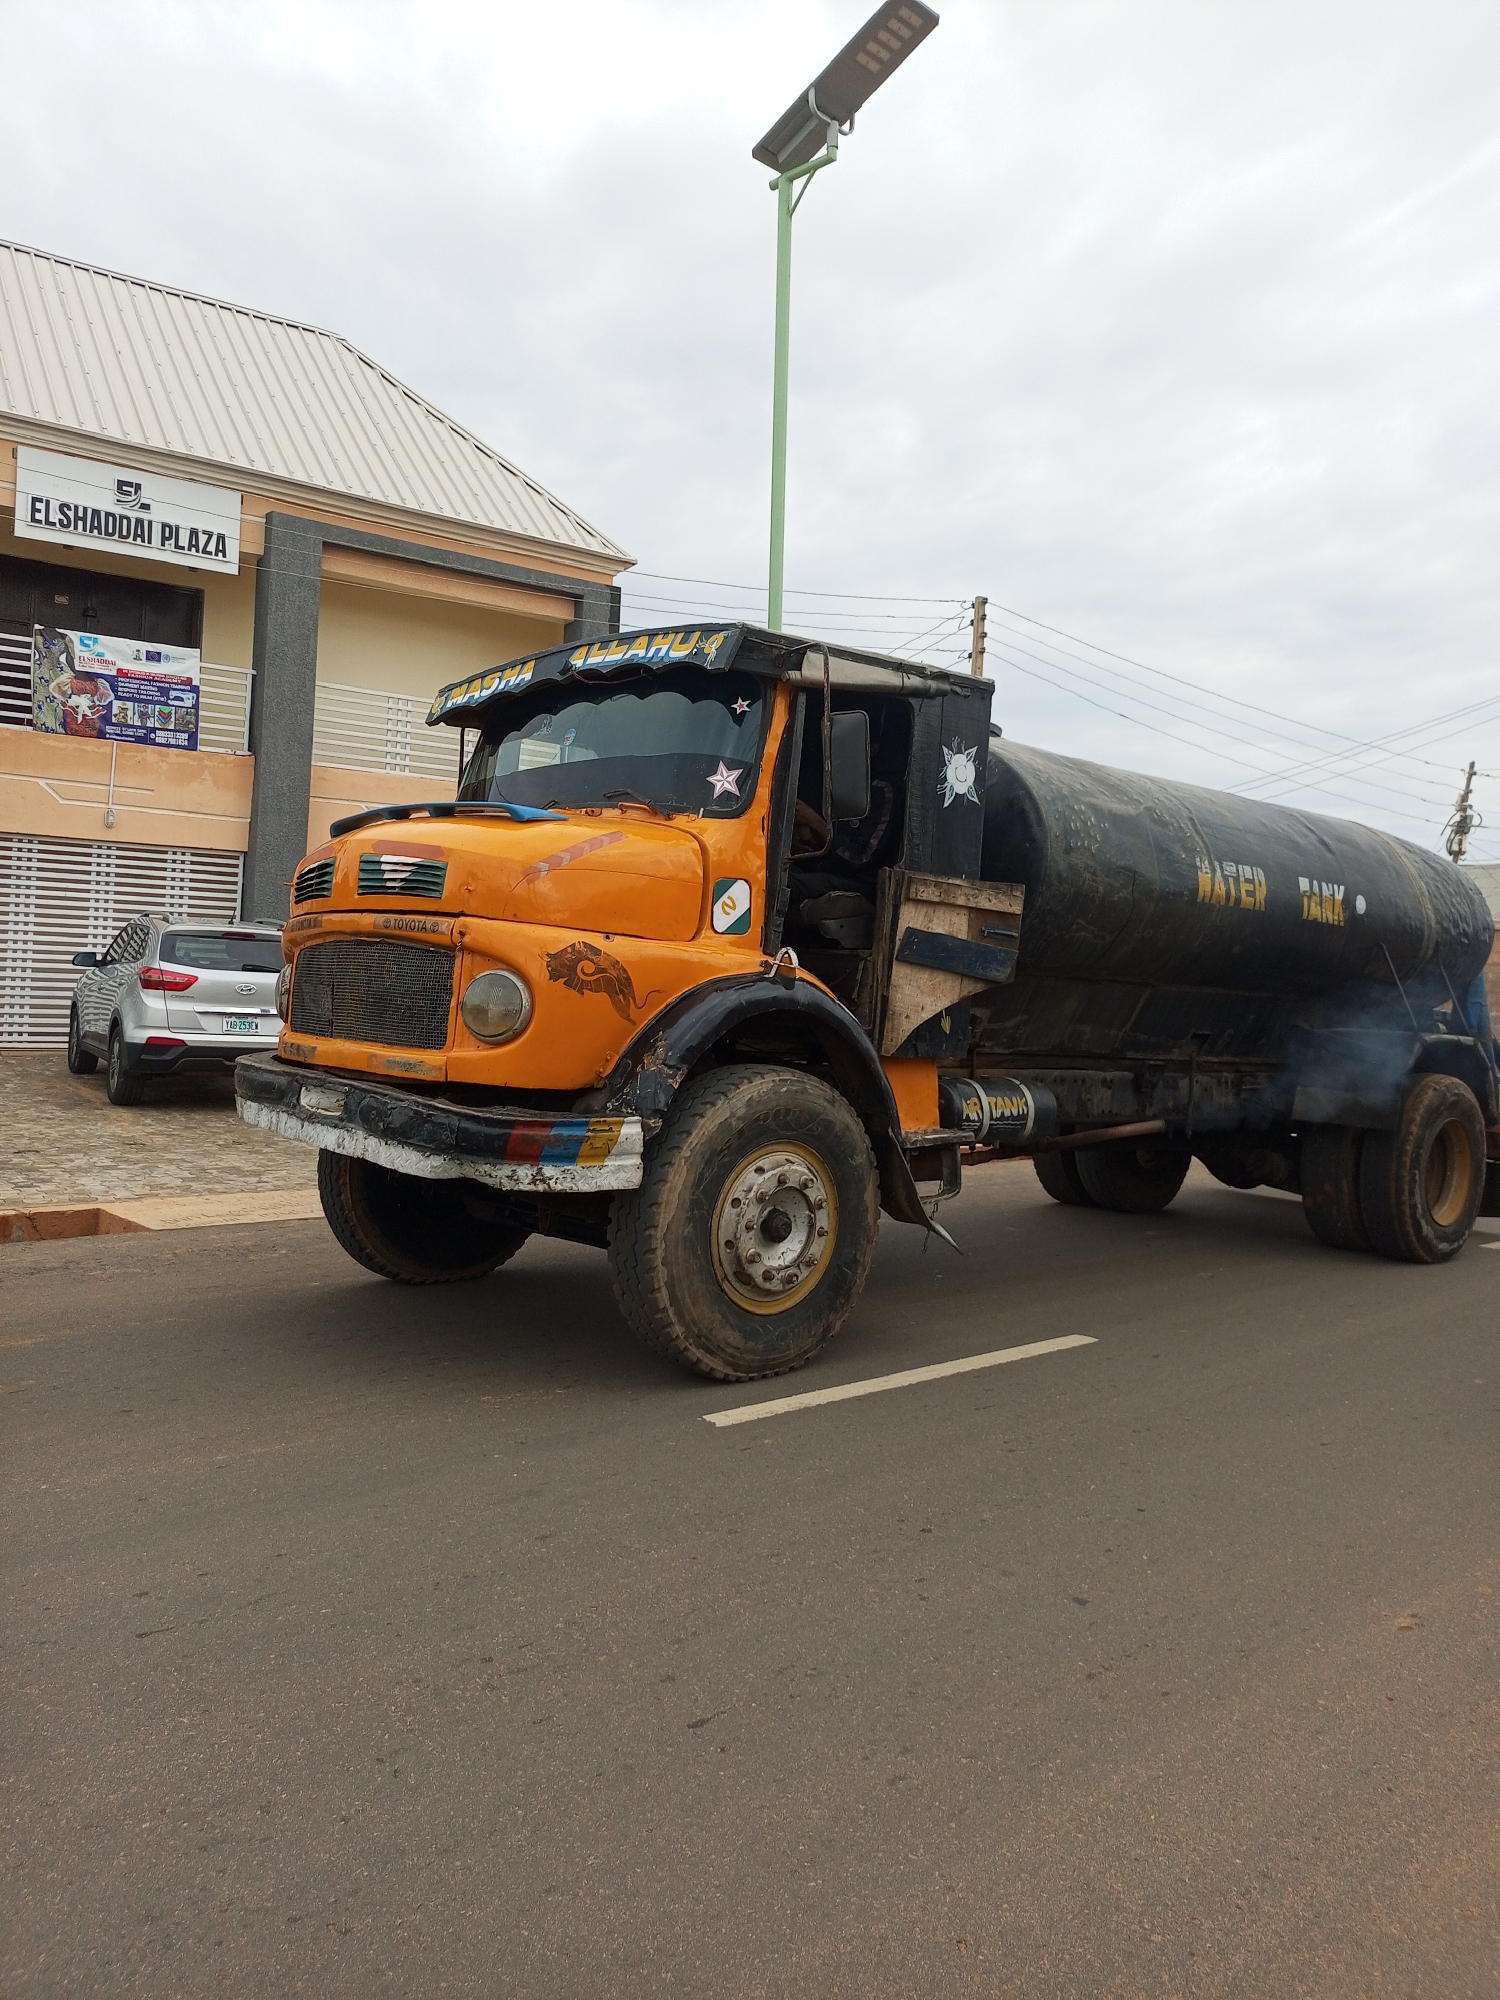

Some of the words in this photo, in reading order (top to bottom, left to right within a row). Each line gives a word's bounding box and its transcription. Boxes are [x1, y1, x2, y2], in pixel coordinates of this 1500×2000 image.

[30, 496, 153, 545] ELSHADDAI
[160, 522, 227, 559] PLAZA
[79, 655, 117, 666] ELSHADDAI
[446, 659, 536, 708] MASHA
[569, 631, 701, 669] ALLAHU
[1195, 856, 1267, 911] WATER
[1298, 876, 1346, 927] TANK
[393, 918, 427, 932] TOYOTA
[986, 1095, 1028, 1119] TANK
